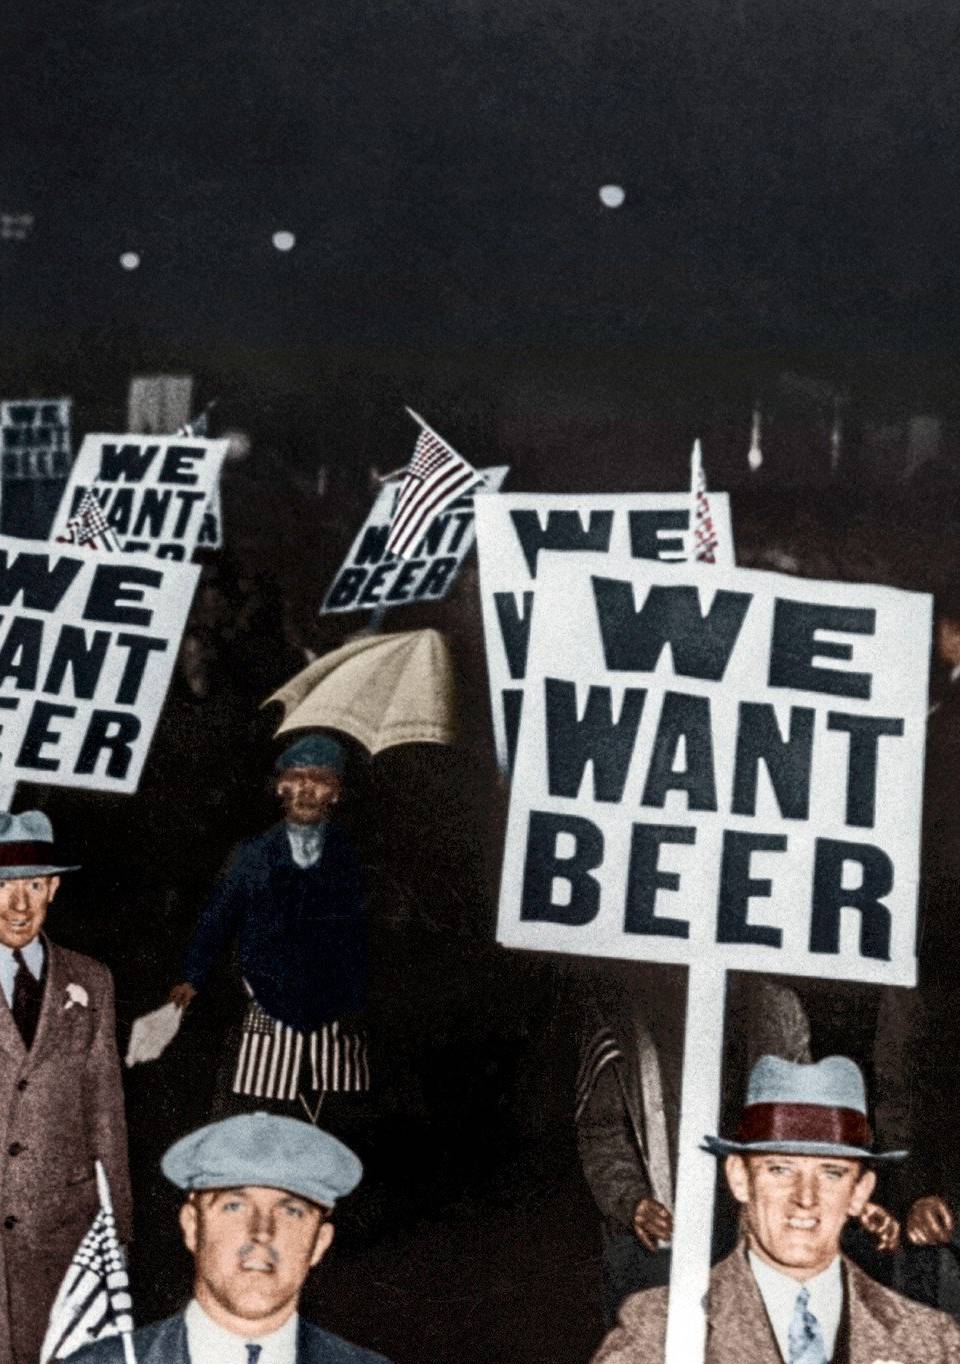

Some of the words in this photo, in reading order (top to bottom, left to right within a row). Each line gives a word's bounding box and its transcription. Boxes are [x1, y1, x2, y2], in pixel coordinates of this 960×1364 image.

[100, 444, 207, 485] WE
[324, 556, 459, 610] BEER
[353, 511, 474, 566] WNT
[591, 574, 876, 701] WE
[544, 677, 905, 829] WANT
[519, 810, 895, 963] BEER
